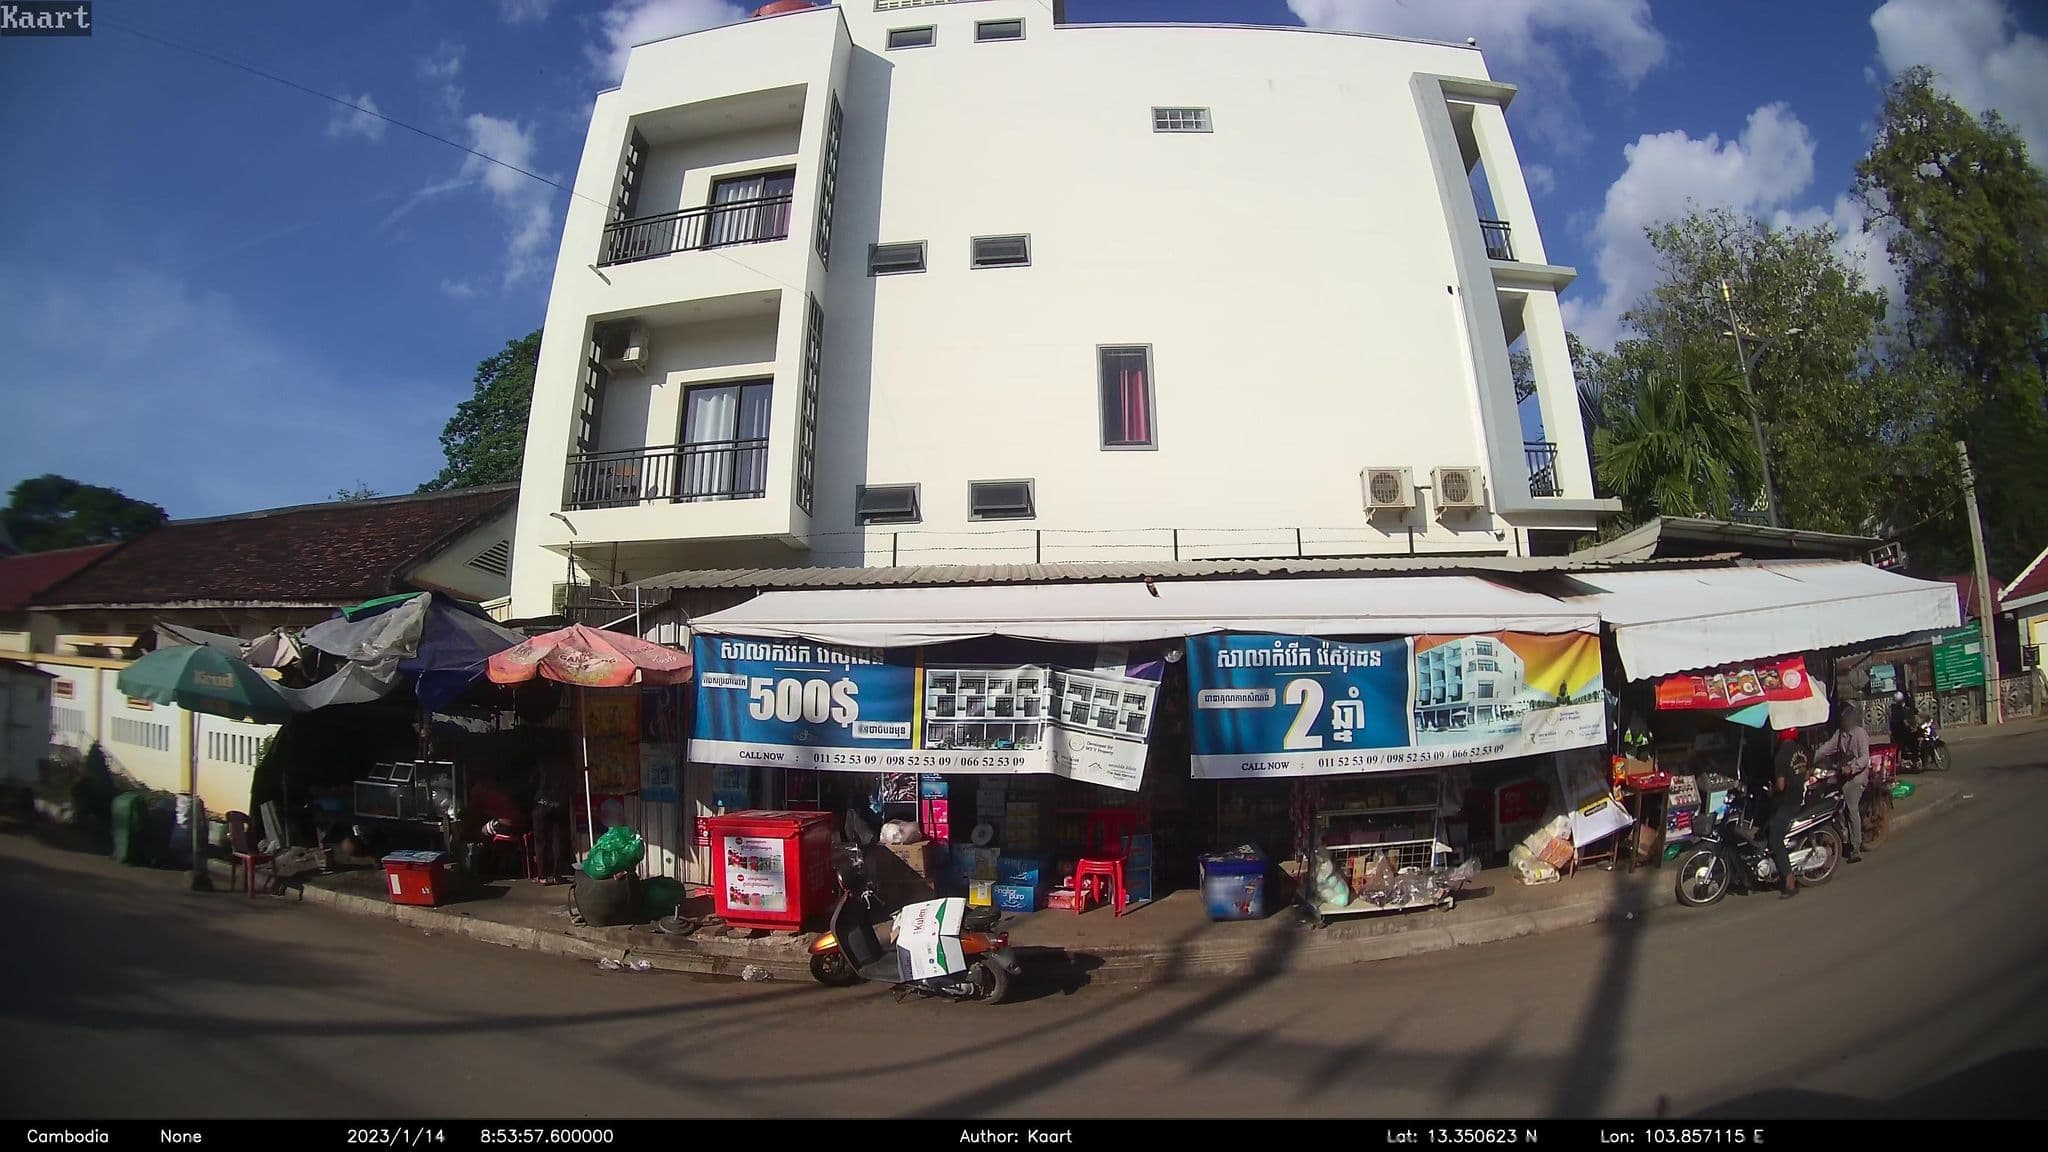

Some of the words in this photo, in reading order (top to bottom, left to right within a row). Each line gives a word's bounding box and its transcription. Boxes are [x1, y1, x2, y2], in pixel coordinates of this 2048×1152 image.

[749, 677, 859, 728] 500$
[1283, 678, 1324, 750] 2
[1331, 687, 1365, 742] ឆ្នាំ
[739, 751, 762, 760] CALL
[763, 752, 785, 761] NOW
[813, 753, 830, 763] 011
[834, 754, 846, 764] 52
[849, 755, 861, 764] 53
[864, 756, 877, 765] 09
[886, 756, 905, 766] 098
[907, 757, 920, 766] 52
[923, 757, 936, 766] 53
[938, 757, 951, 766] 09
[960, 757, 979, 767] 066
[982, 757, 995, 767] 52
[997, 758, 1010, 767] 53
[1012, 757, 1025, 767] 09
[1241, 763, 1266, 771] CALL
[1268, 762, 1290, 770] NOW
[1318, 758, 1334, 768] 011
[1338, 757, 1349, 766] 52
[1352, 756, 1364, 765] 53
[1366, 755, 1378, 764] 09
[1387, 754, 1404, 763] 098
[1406, 753, 1418, 762] 52
[1420, 752, 1431, 761] 53
[1433, 751, 1445, 760] 09
[1452, 750, 1468, 759] 066
[1470, 747, 1480, 757] 52
[1482, 746, 1493, 756] 53
[1494, 743, 1504, 754] 09
